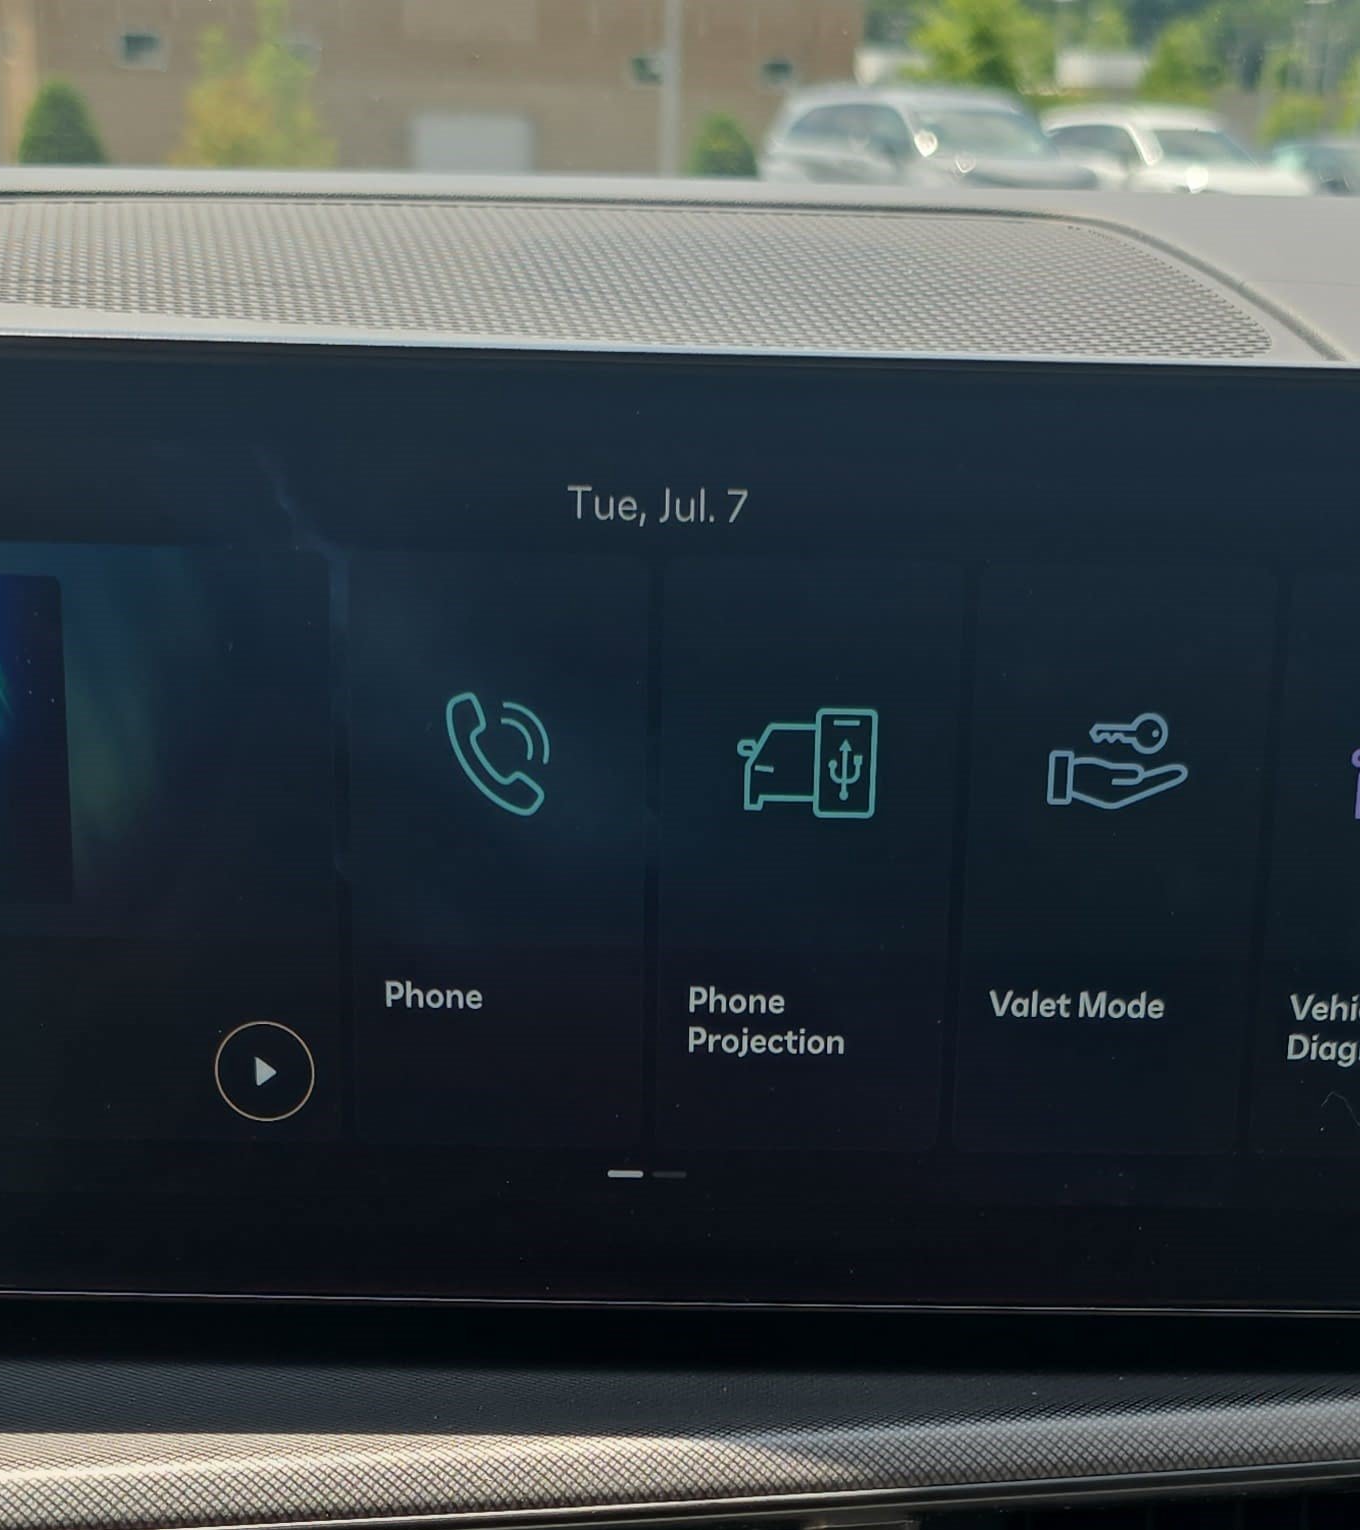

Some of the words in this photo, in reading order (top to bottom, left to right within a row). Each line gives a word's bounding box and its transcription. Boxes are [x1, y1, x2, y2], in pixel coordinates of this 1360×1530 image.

[567, 484, 648, 528] Tue,
[658, 486, 717, 525] Jul.
[726, 488, 750, 525] 7
[383, 980, 484, 1012] Phone
[687, 985, 787, 1017] Phone
[988, 990, 1072, 1020] Valet
[1077, 991, 1166, 1020] Mode
[686, 1026, 847, 1061] Projection
